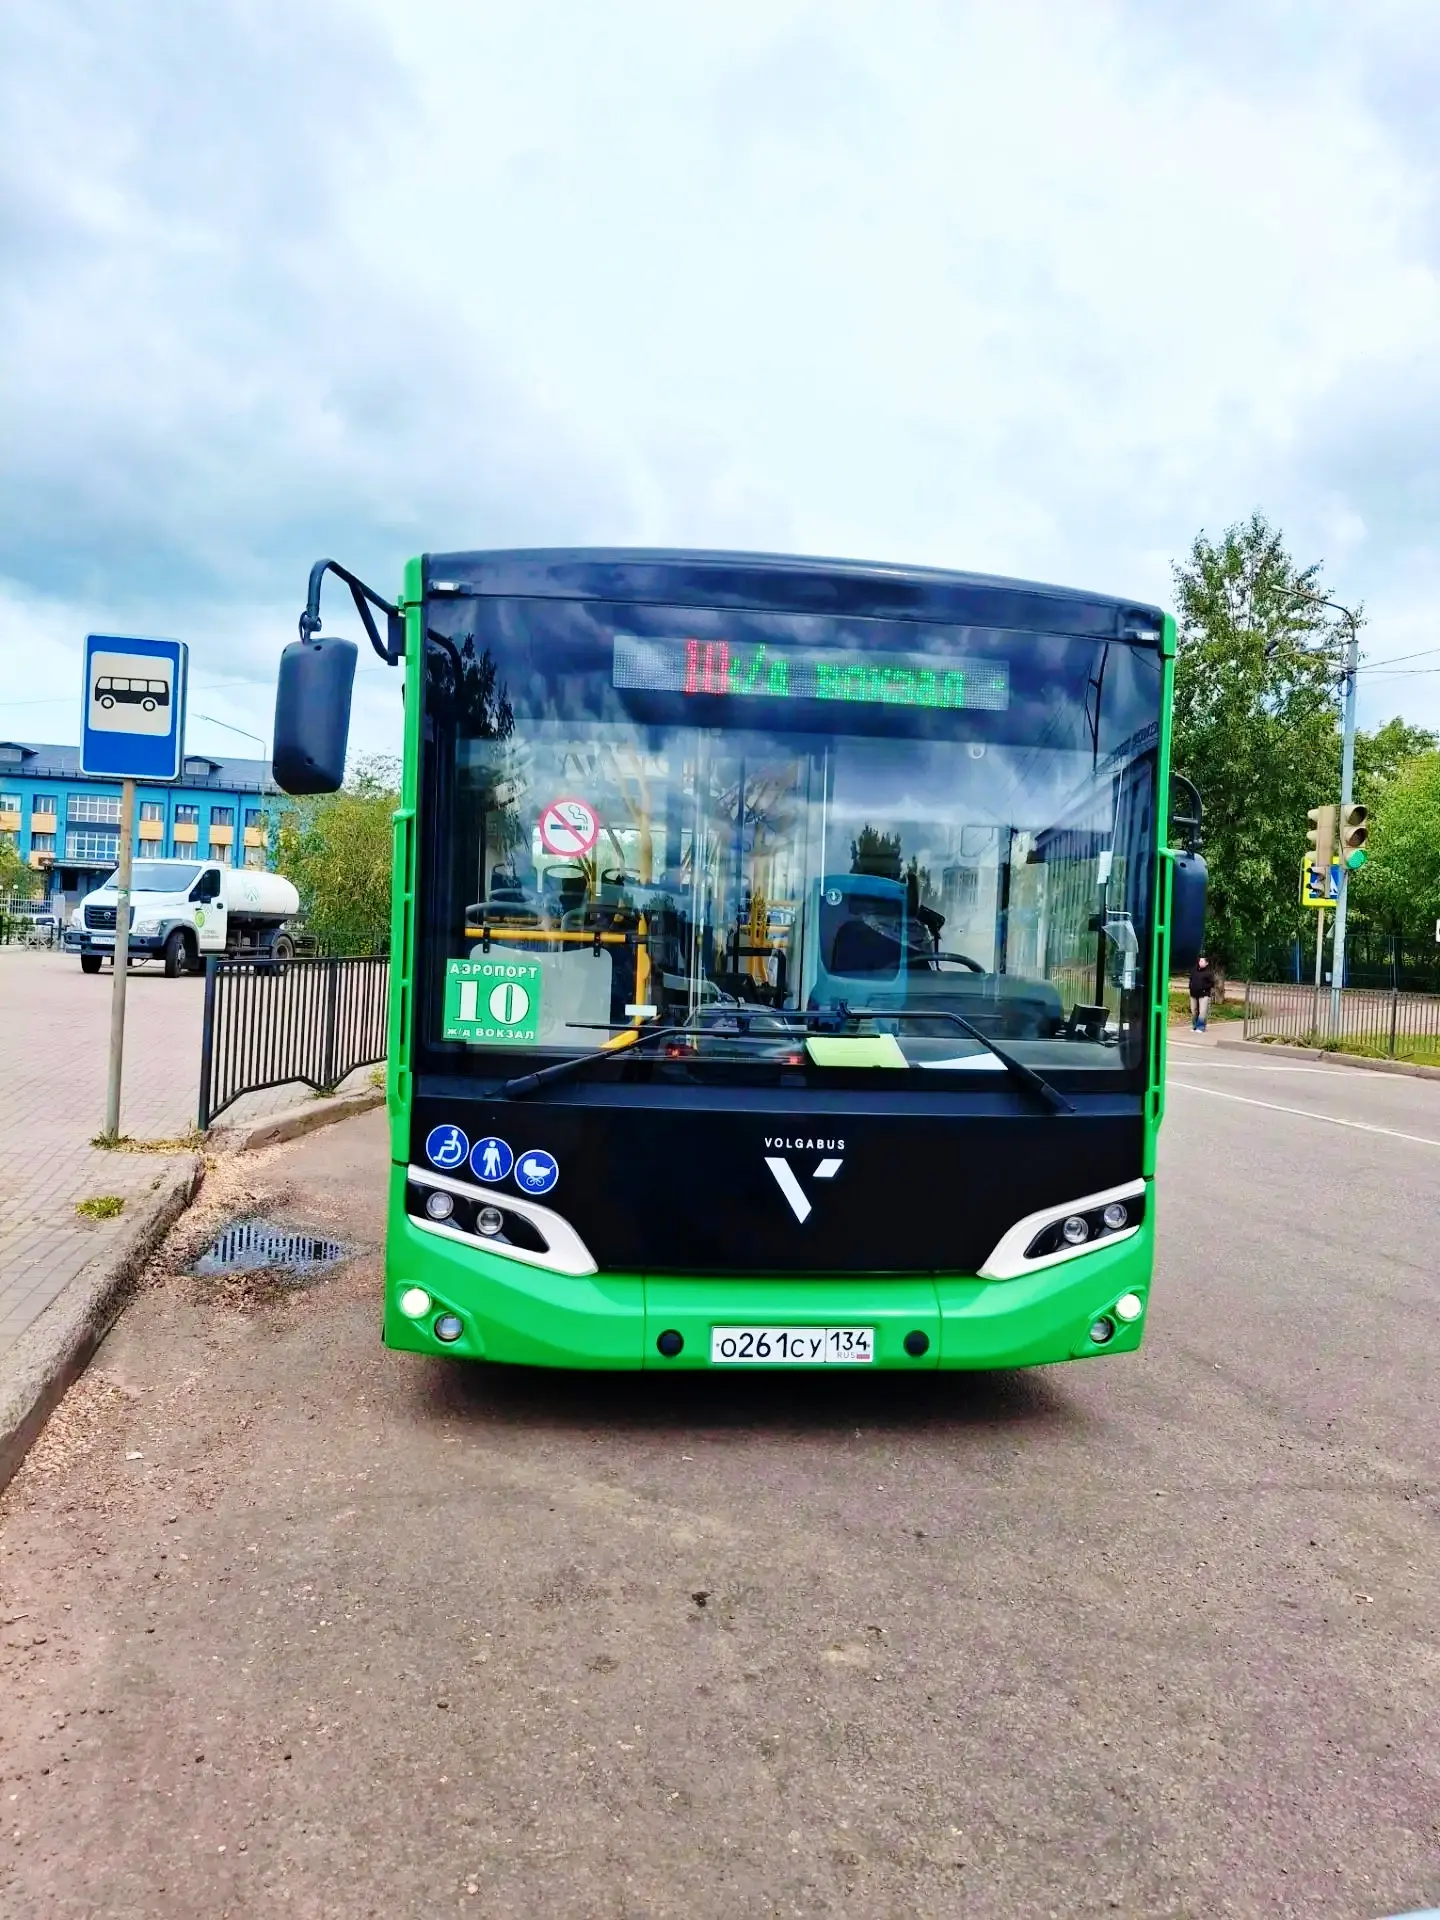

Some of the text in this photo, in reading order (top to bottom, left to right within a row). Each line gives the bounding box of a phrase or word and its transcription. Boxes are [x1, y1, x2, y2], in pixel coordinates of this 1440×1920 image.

[450, 963, 538, 979] АЭРОПОРТ
[453, 980, 530, 1025] 10
[475, 1027, 535, 1040] ВОКЗАЛ
[764, 1137, 846, 1150] VOLGABUS
[829, 1331, 867, 1351] 134
[836, 1351, 856, 1359] RUS
